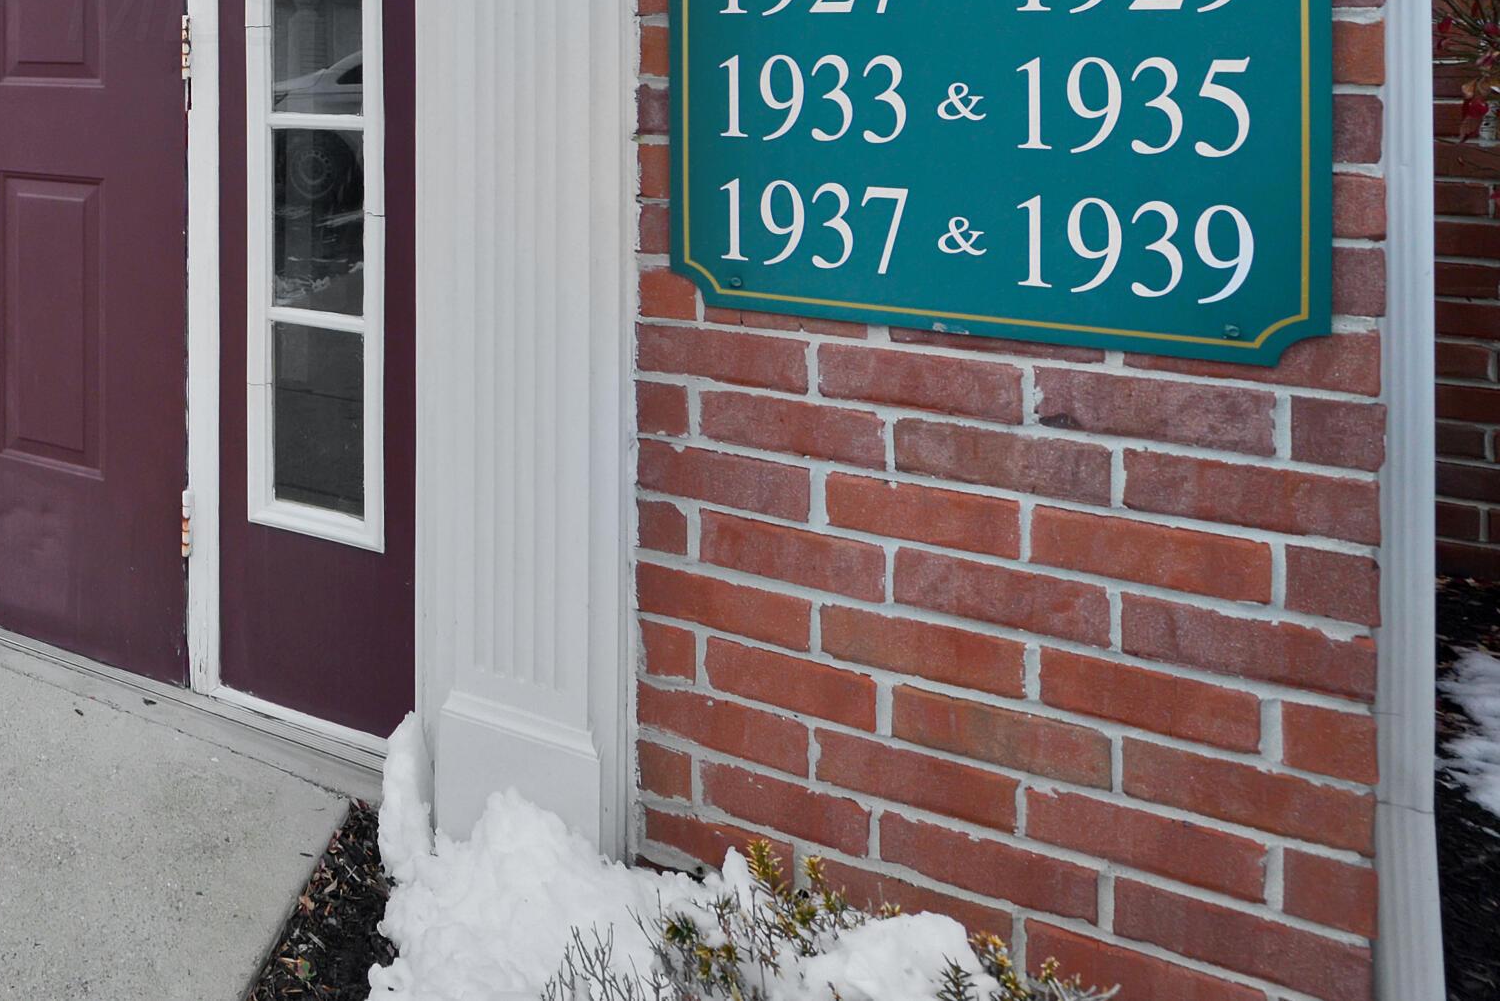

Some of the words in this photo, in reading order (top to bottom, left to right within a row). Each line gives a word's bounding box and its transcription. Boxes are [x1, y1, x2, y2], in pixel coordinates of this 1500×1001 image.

[719, 54, 907, 144] 1933
[937, 82, 987, 121] &
[1016, 56, 1251, 158] 1935
[719, 177, 909, 275] 1937
[937, 216, 987, 256] &
[1016, 194, 1255, 304] 1939
